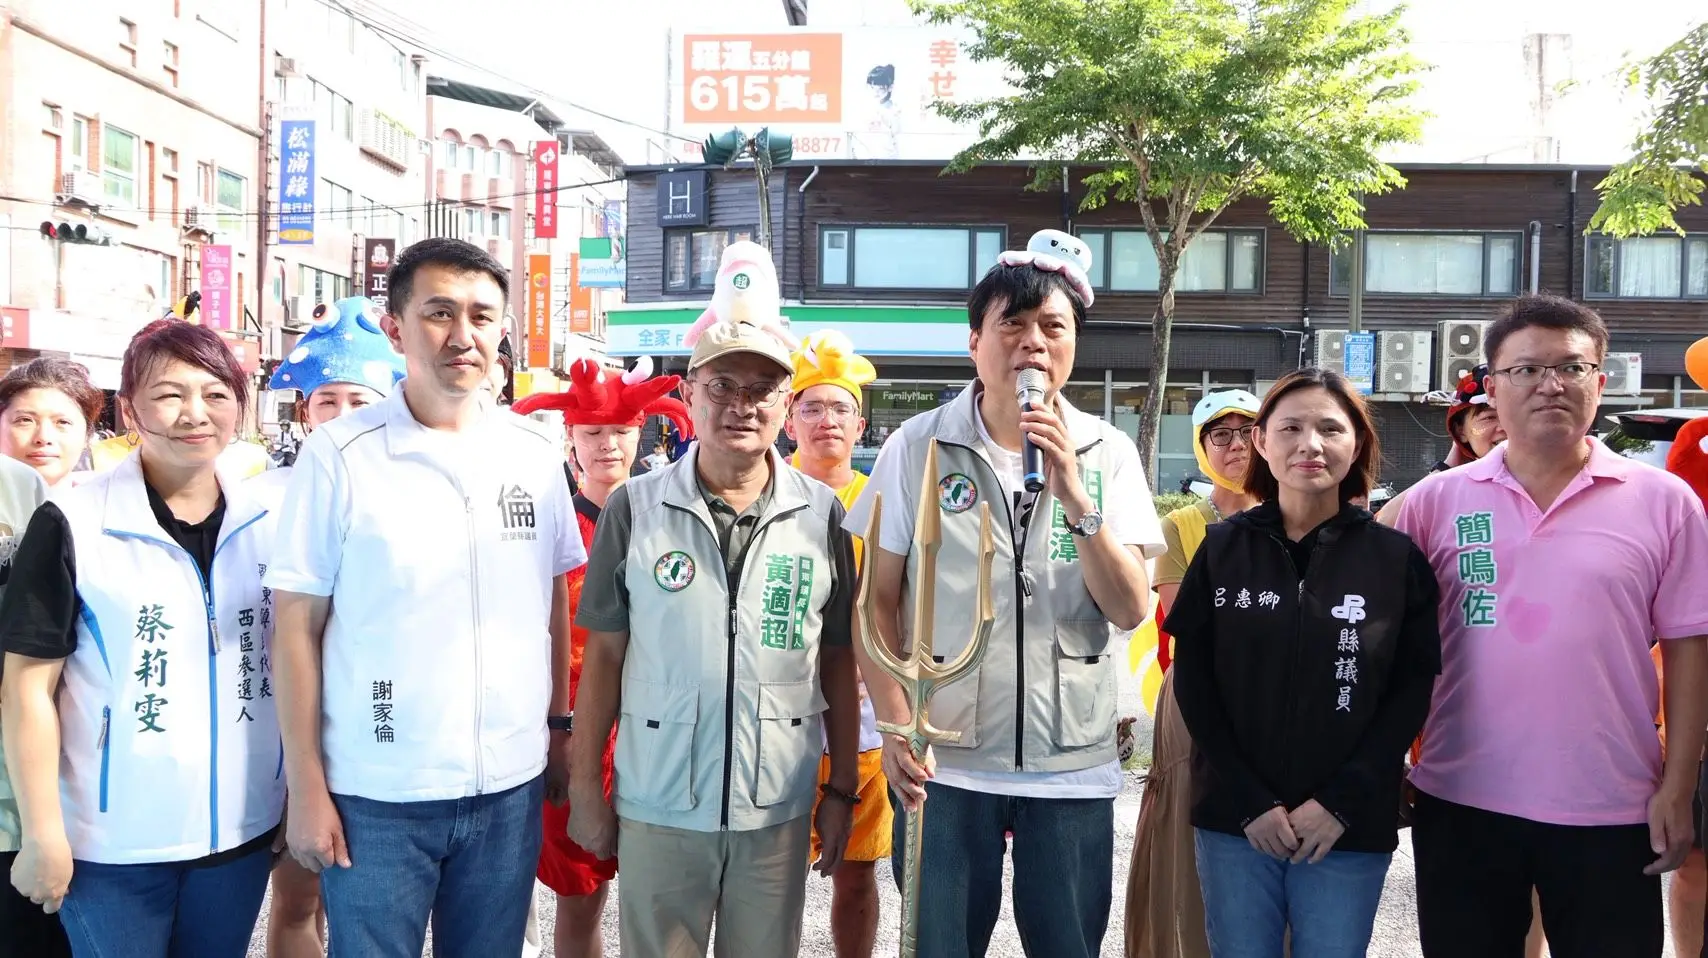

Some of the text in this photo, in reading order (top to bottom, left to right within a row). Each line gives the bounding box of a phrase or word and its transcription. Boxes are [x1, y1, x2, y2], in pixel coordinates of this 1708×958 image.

[928, 40, 957, 97] 幸せ
[581, 265, 625, 277] FamilyMar
[638, 329, 671, 347] 全家
[882, 391, 934, 402] FamilyMart
[497, 484, 536, 528] 倫
[1214, 587, 1281, 610] 呂惠卿
[1455, 512, 1497, 627] 簡鳴佐
[760, 553, 794, 650] 黃適超
[134, 603, 175, 733] 蔡莉雯
[236, 608, 256, 723] 西區參選人
[1334, 627, 1360, 712] 縣議員
[372, 679, 395, 743] 謝家倫
